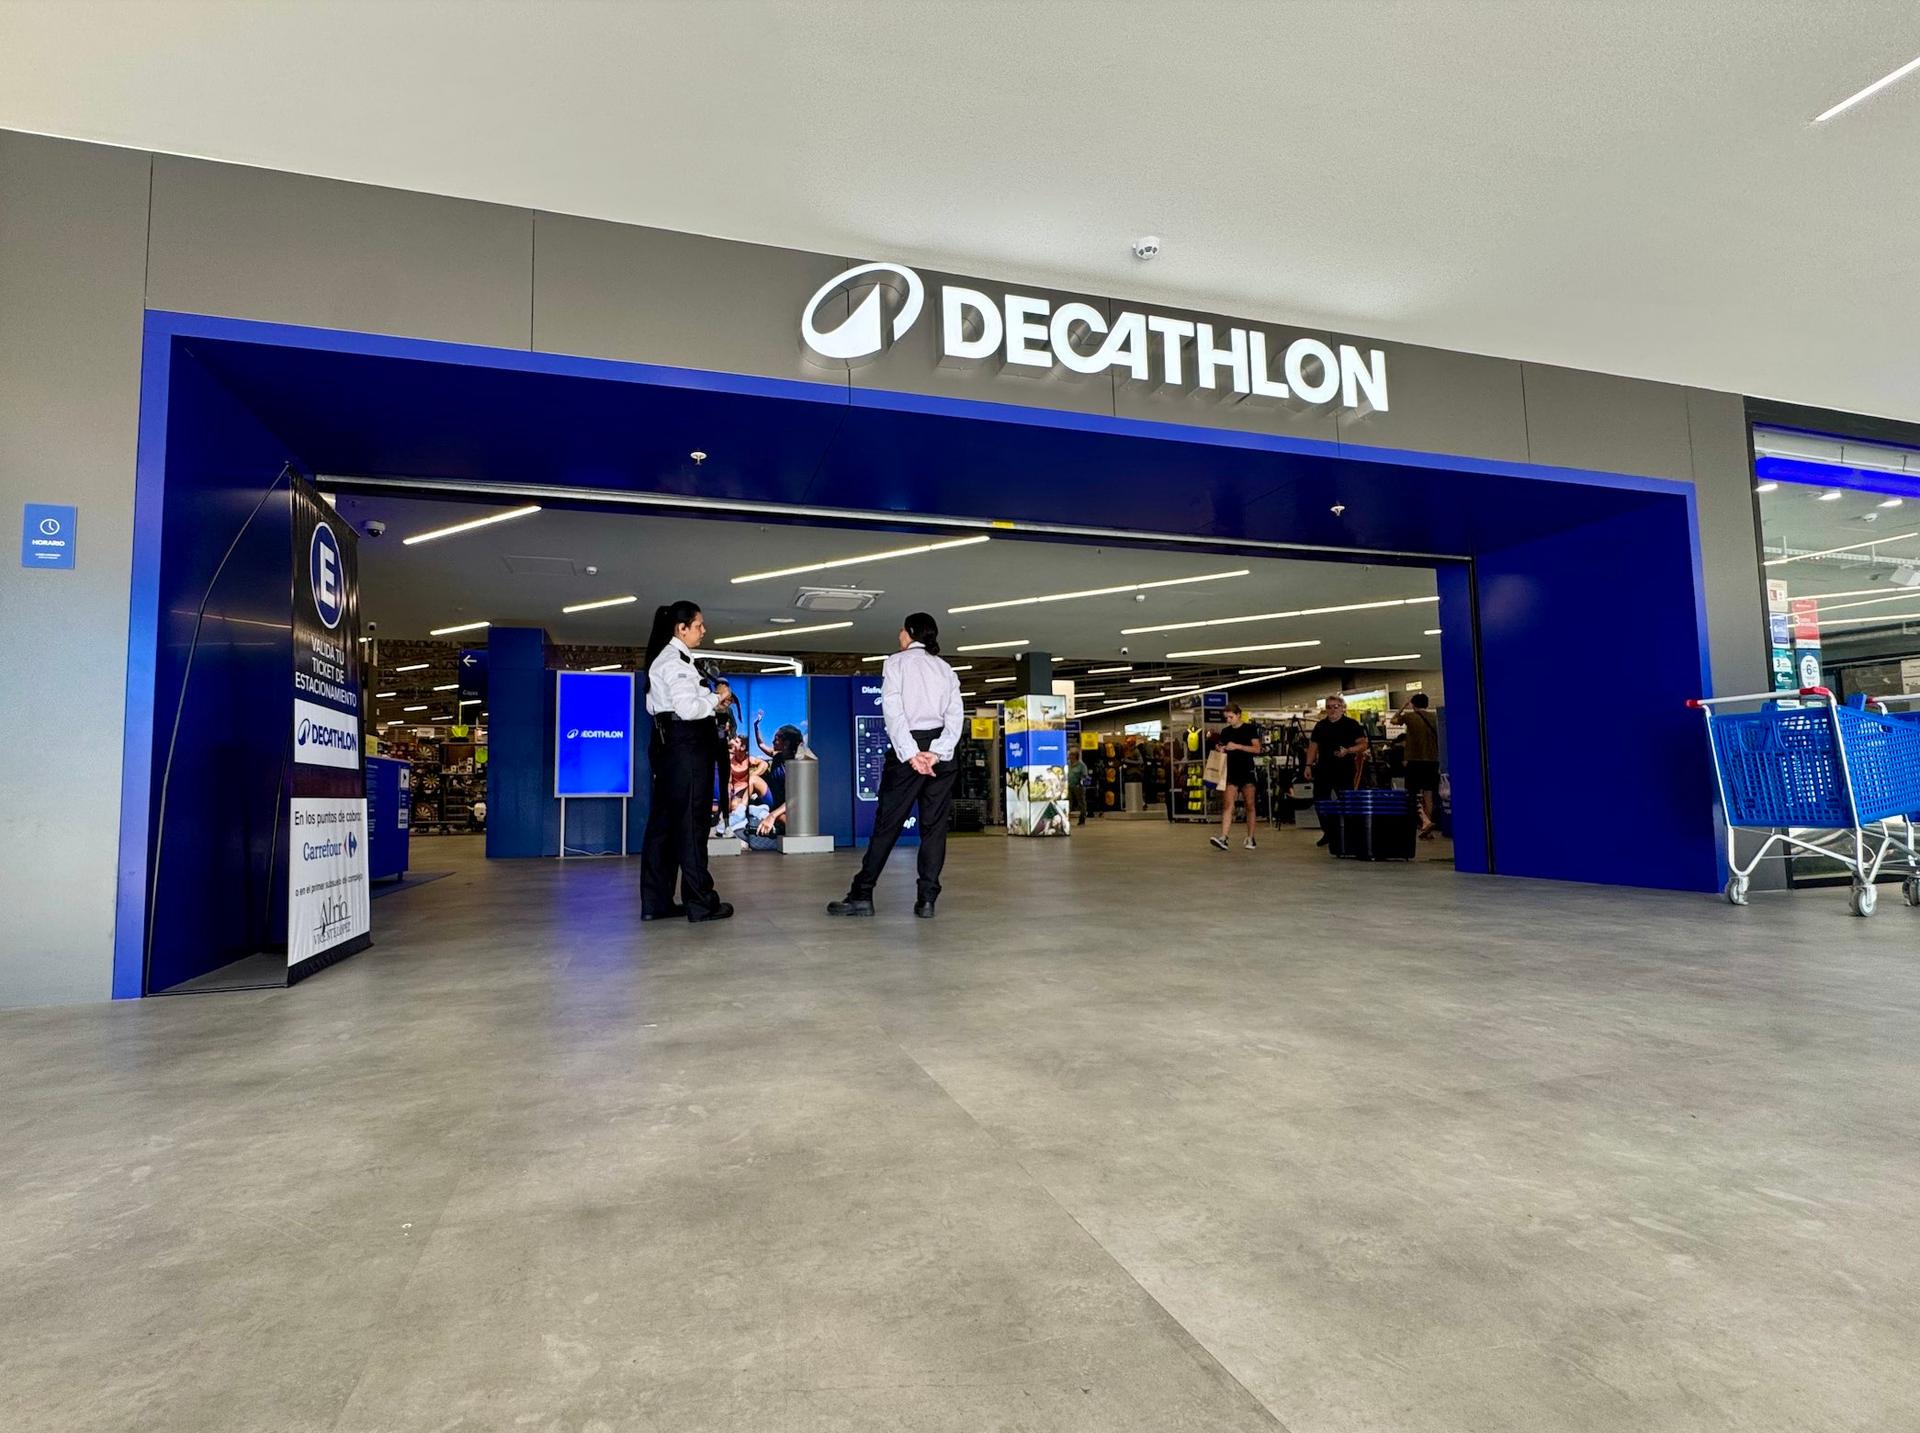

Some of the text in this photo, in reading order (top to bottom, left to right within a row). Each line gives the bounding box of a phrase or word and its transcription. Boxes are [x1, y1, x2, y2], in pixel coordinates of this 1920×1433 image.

[941, 285, 1389, 412] DECATHLON
[319, 541, 336, 610] E
[311, 634, 345, 666] VALIDA TU
[311, 656, 345, 685] TICKET DE
[295, 671, 357, 708] ESTACIONAMIENTO
[311, 723, 358, 752] DECATHLON
[294, 810, 304, 826] En
[305, 809, 316, 825] los
[316, 810, 338, 828] puntos
[338, 809, 346, 823] de
[303, 838, 342, 862] Carrefour
